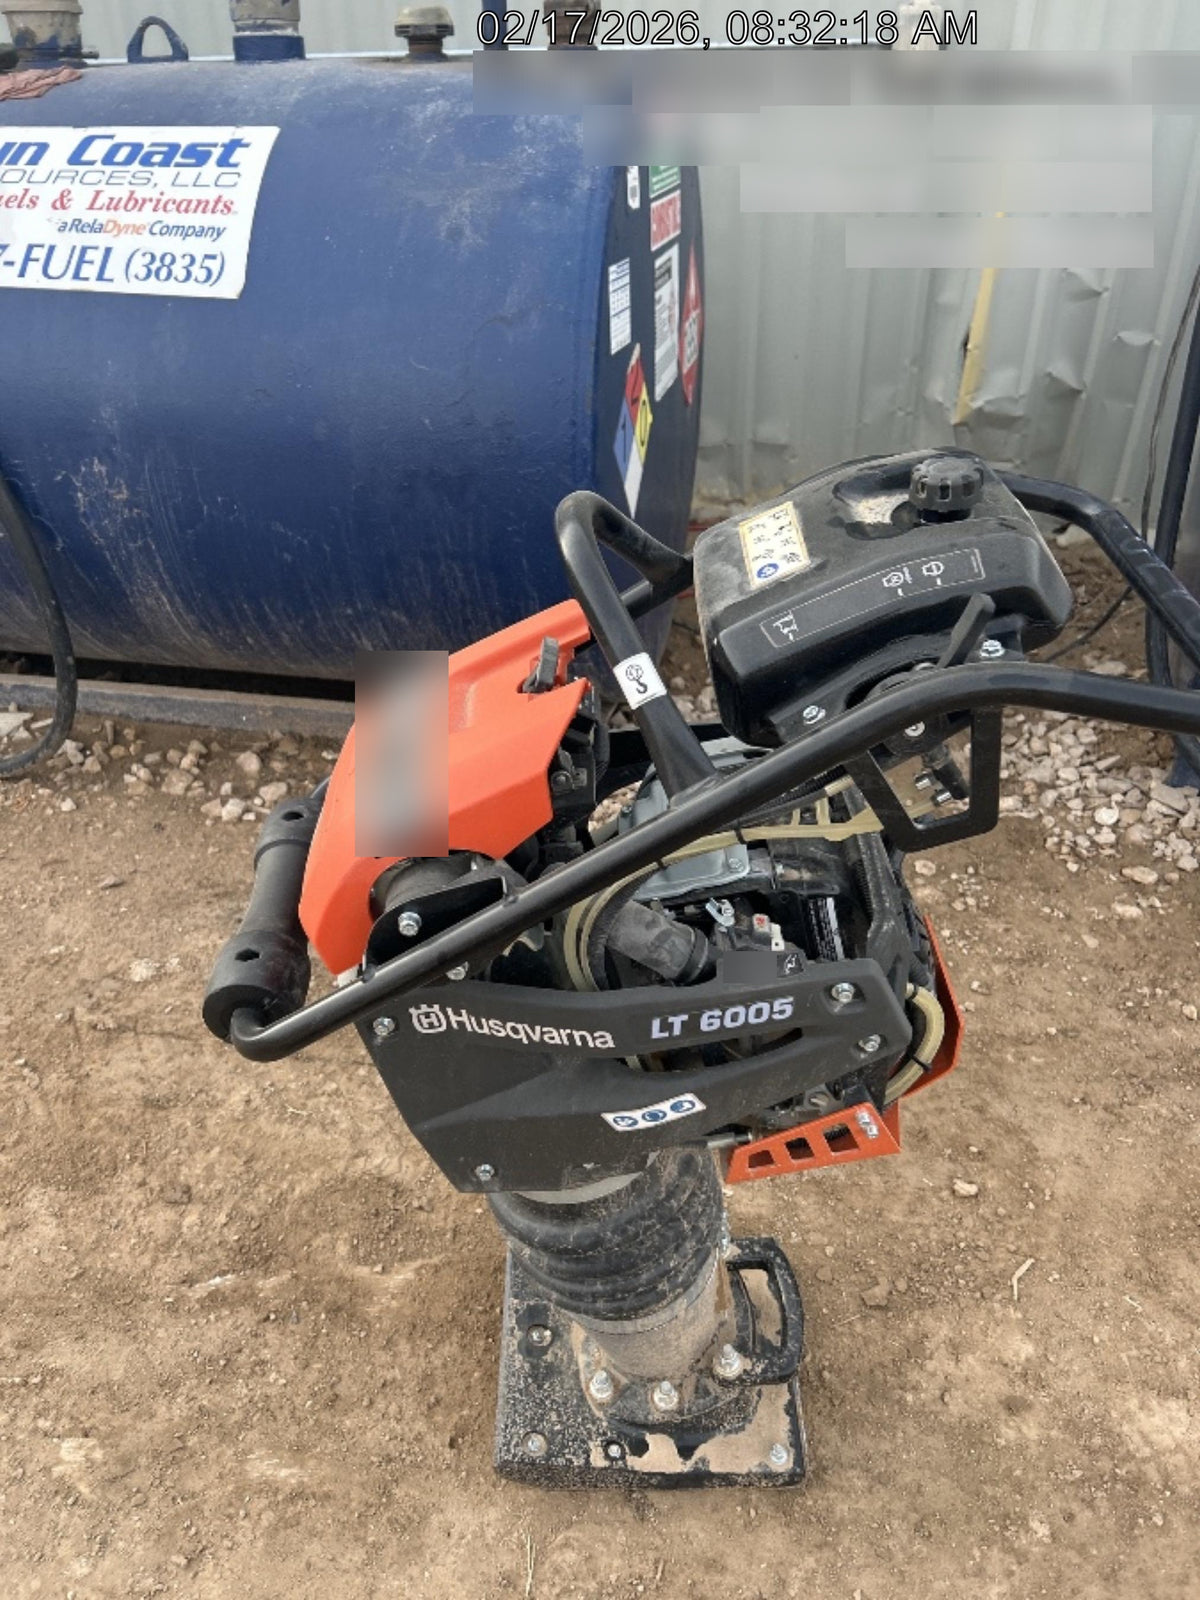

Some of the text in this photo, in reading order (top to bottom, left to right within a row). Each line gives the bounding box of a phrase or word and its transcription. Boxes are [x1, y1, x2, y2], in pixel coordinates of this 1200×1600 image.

[67, 135, 251, 168] Coast
[171, 171, 241, 188] LLC
[0, 188, 234, 216] els & Lubricants
[57, 218, 226, 242] a RelaDyne Company
[124, 248, 225, 287] (3835)
[446, 1007, 616, 1049] Husqvarna
[651, 996, 794, 1039] LT 6005
